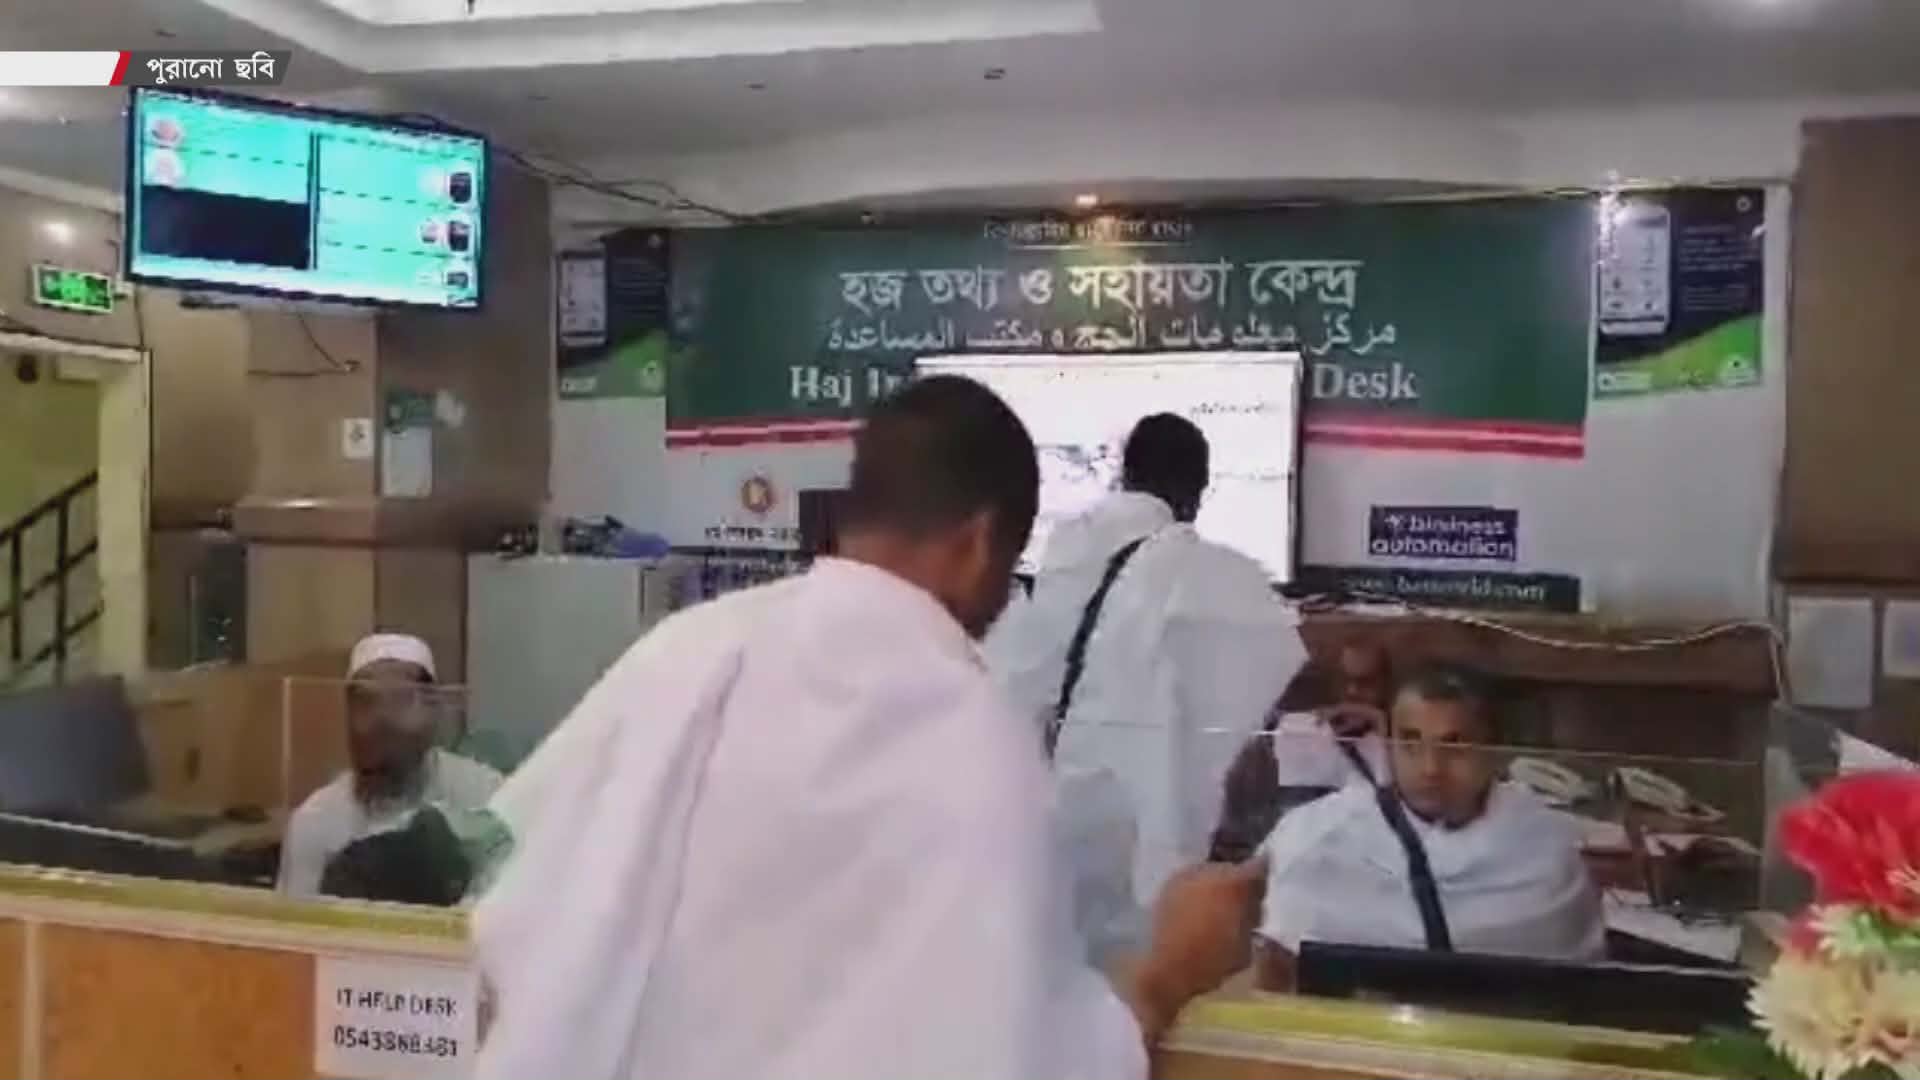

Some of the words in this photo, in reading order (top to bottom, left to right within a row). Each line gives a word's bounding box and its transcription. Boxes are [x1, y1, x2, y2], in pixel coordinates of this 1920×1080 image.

[839, 270, 908, 316] হজ
[918, 265, 1005, 310] তথ্য
[1018, 267, 1053, 305] ও
[1246, 259, 1364, 308] কেন্দ্র
[1305, 312, 1397, 354] مركز
[790, 365, 852, 408] Haj
[1313, 362, 1419, 399] Desk
[337, 988, 352, 1008] IT
[359, 991, 405, 1011] HELP
[410, 995, 457, 1016] DESK
